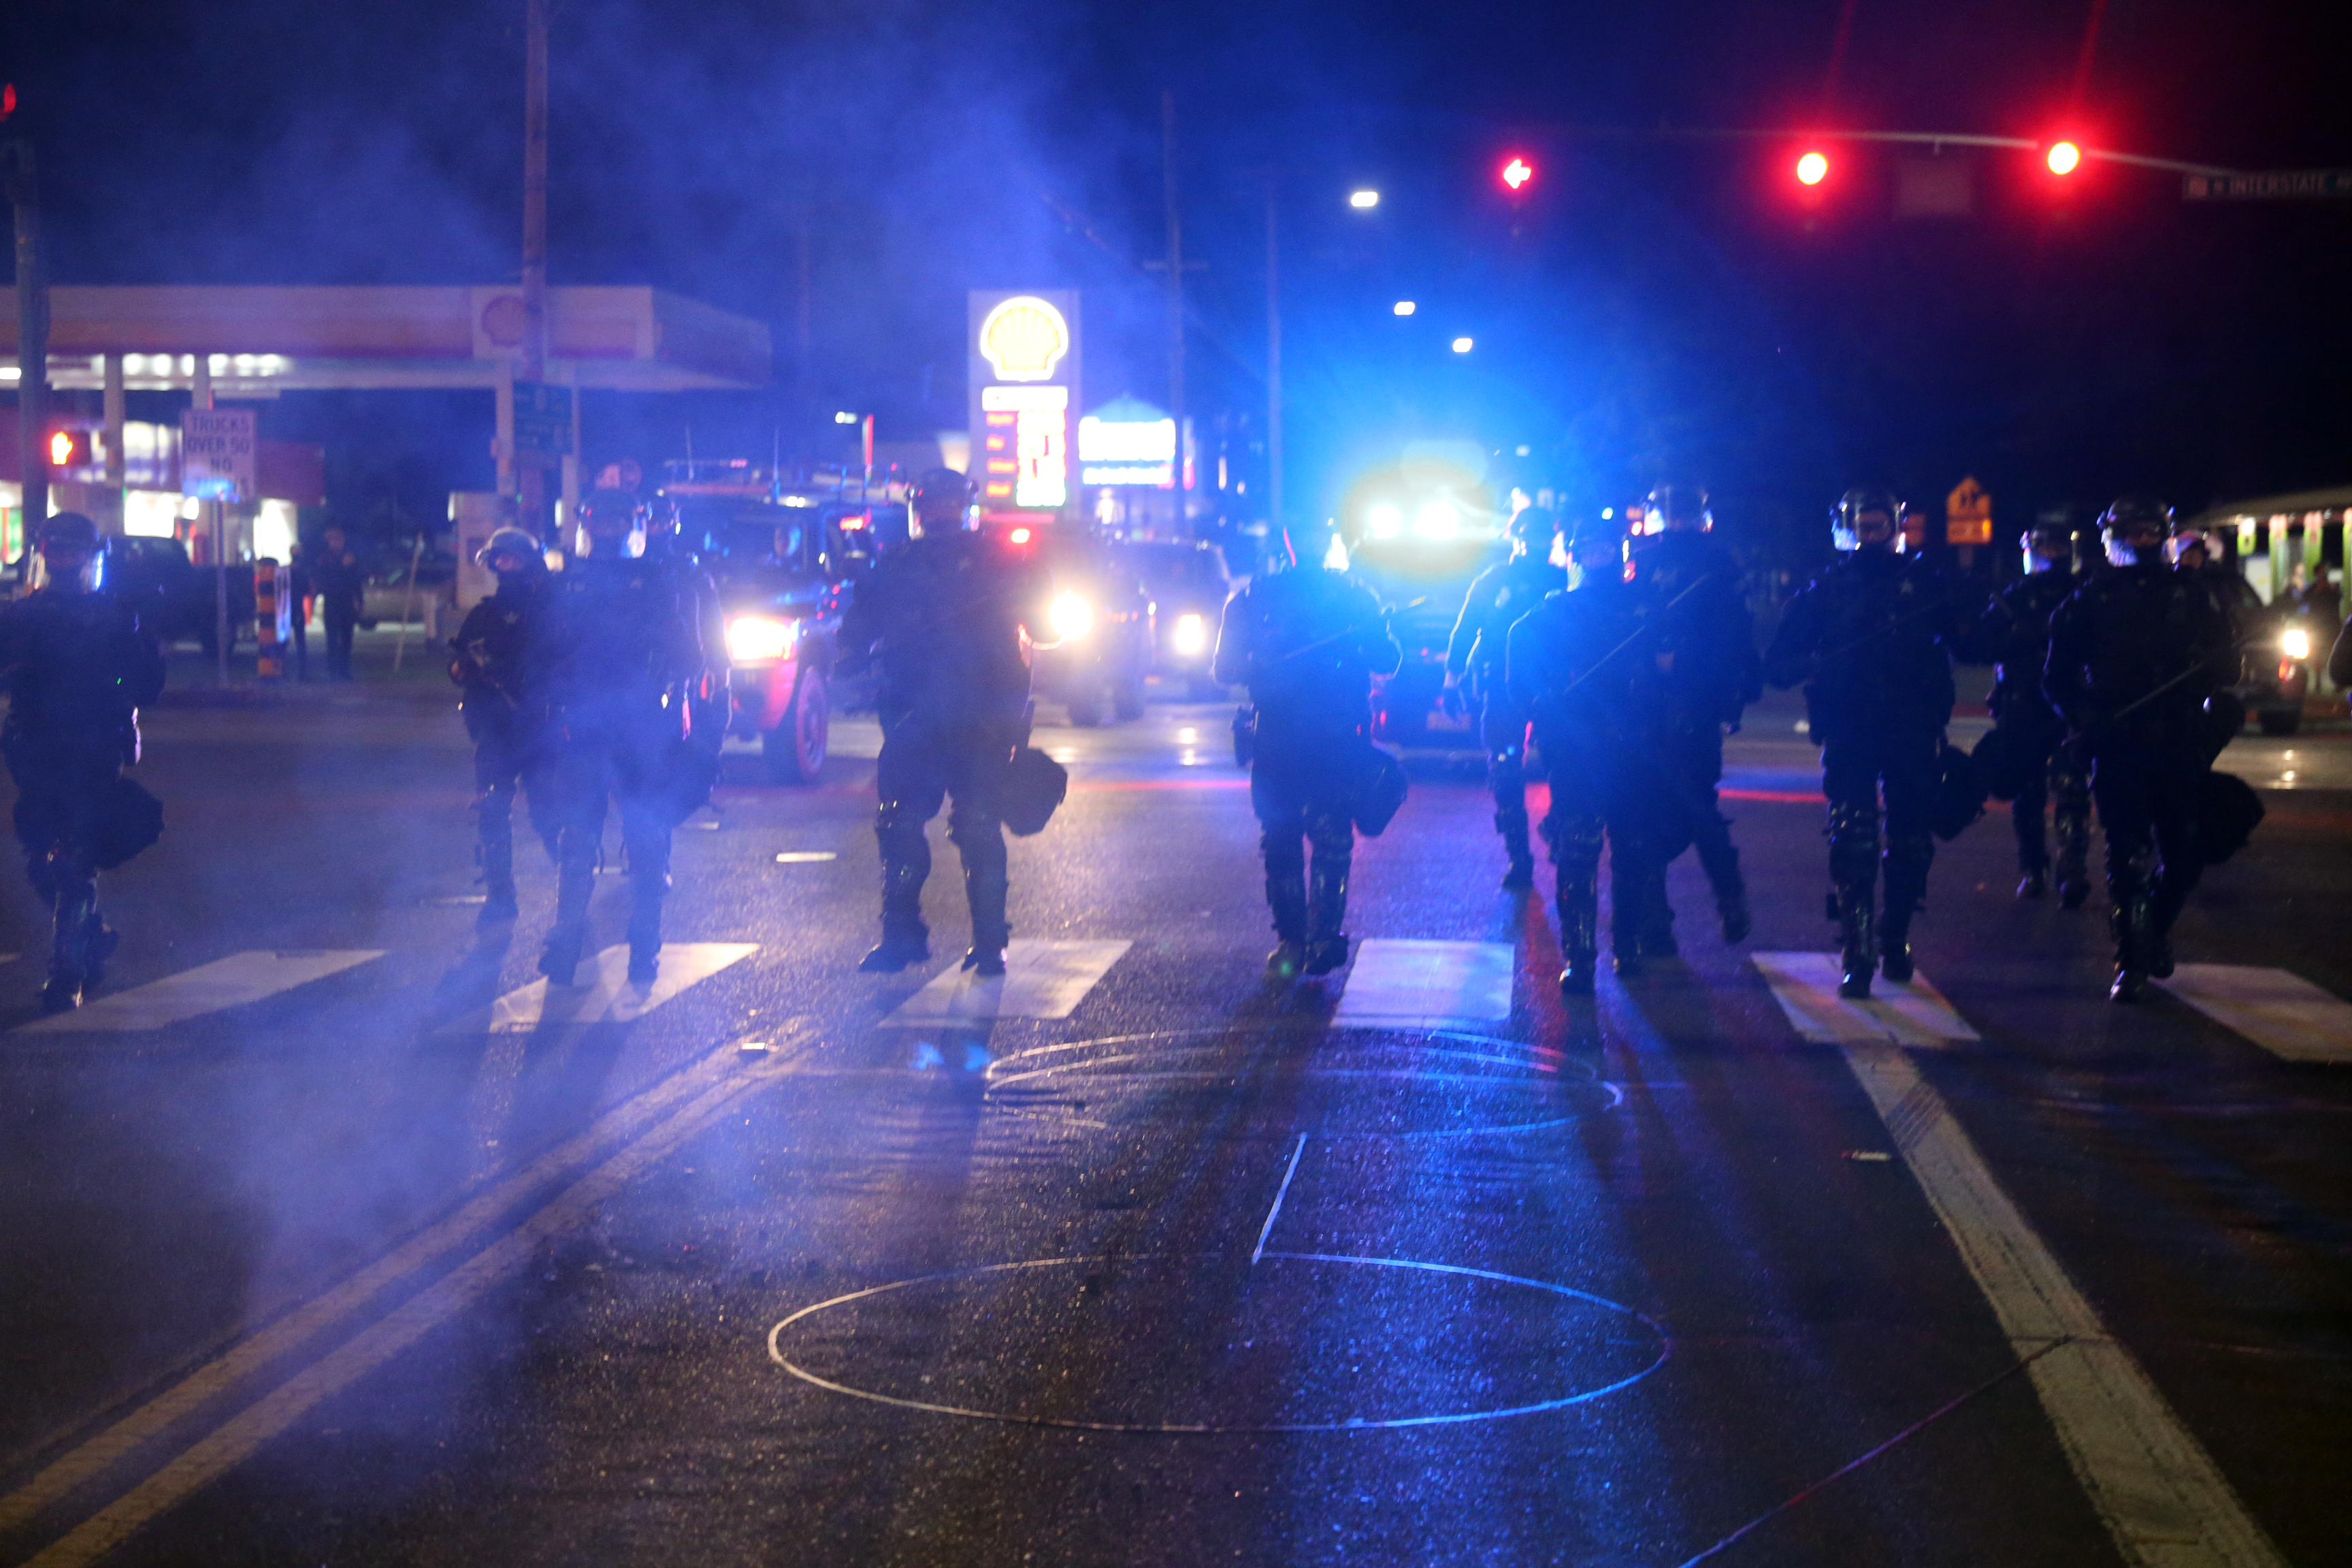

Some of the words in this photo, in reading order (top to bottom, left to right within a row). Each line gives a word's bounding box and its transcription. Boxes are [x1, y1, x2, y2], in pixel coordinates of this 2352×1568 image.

[2229, 174, 2326, 195] INTERSTATE
[193, 416, 250, 433] TRUCKS
[187, 436, 225, 453] OVER
[210, 457, 233, 472] NO
